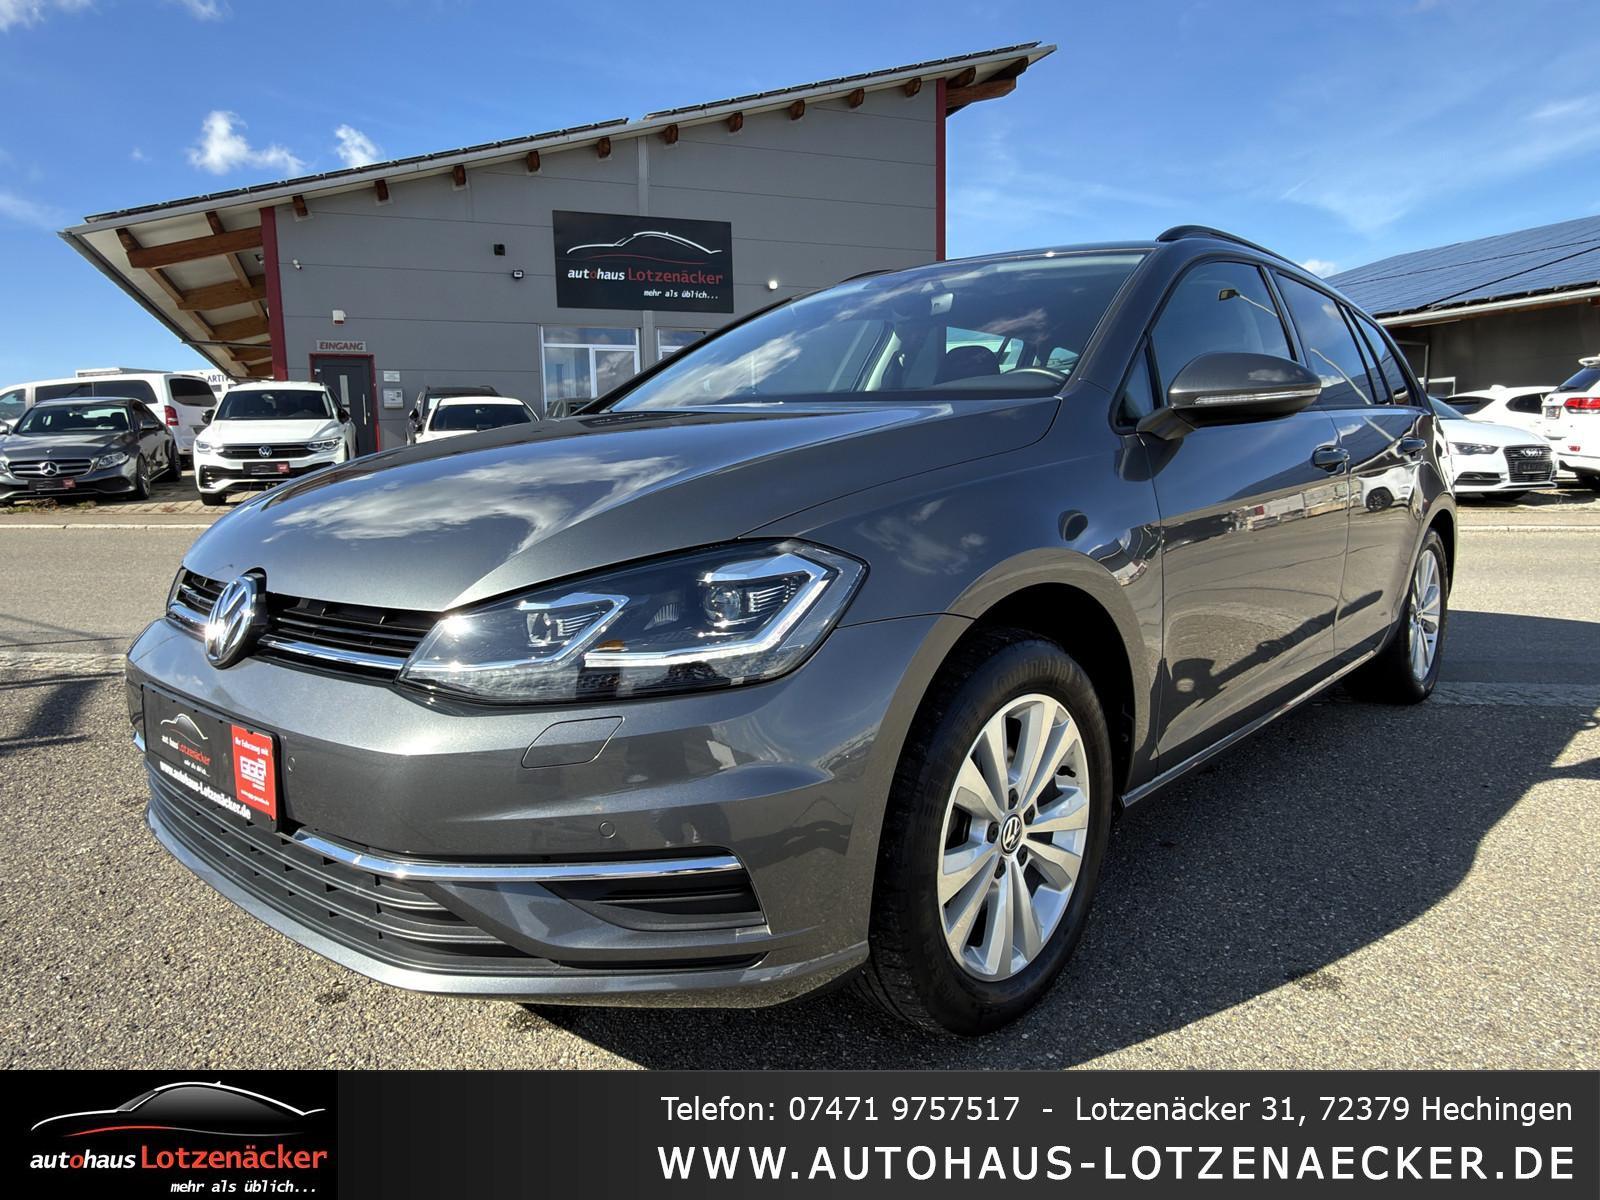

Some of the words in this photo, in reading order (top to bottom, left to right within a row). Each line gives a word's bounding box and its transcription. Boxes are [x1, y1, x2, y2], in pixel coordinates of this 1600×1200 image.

[568, 268, 625, 281] autohaus
[628, 267, 723, 285] Lotzenäcker
[644, 289, 662, 297] mehr
[665, 290, 678, 298] als
[320, 342, 363, 351] EINGANG
